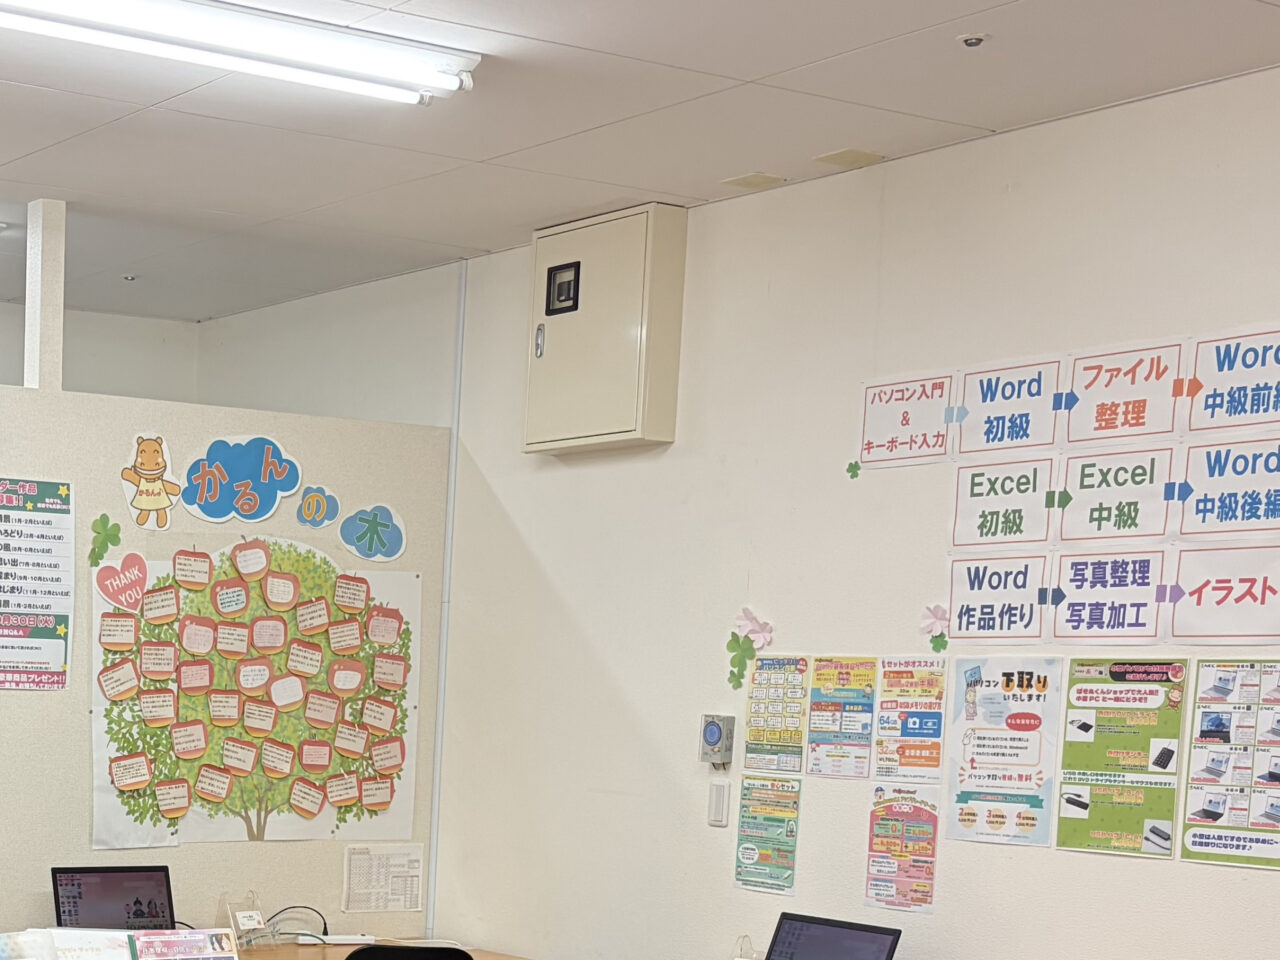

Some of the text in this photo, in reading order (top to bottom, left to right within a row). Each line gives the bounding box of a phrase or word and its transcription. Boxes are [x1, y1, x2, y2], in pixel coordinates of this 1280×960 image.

[1082, 356, 1168, 389] ファイル
[871, 381, 944, 405] パソコン入門
[979, 371, 1042, 403] Word
[900, 411, 910, 426] &
[984, 413, 1030, 443] 初級
[1093, 400, 1147, 431] 整理
[863, 432, 945, 455] キーボード入力
[970, 468, 1038, 498] Excel
[1079, 458, 1156, 489] Excel
[192, 445, 391, 553] かるん の 木
[977, 509, 1023, 537] 初級
[1089, 502, 1139, 530] 中級
[104, 566, 143, 593] THANK
[967, 565, 1029, 591] Word
[1069, 559, 1150, 589] 写真整理
[118, 586, 142, 606] YOU
[1189, 577, 1278, 606] イラスト
[957, 604, 1034, 631] 作品作り
[1066, 602, 1147, 629] 写真加工
[1002, 671, 1048, 689] 下取り
